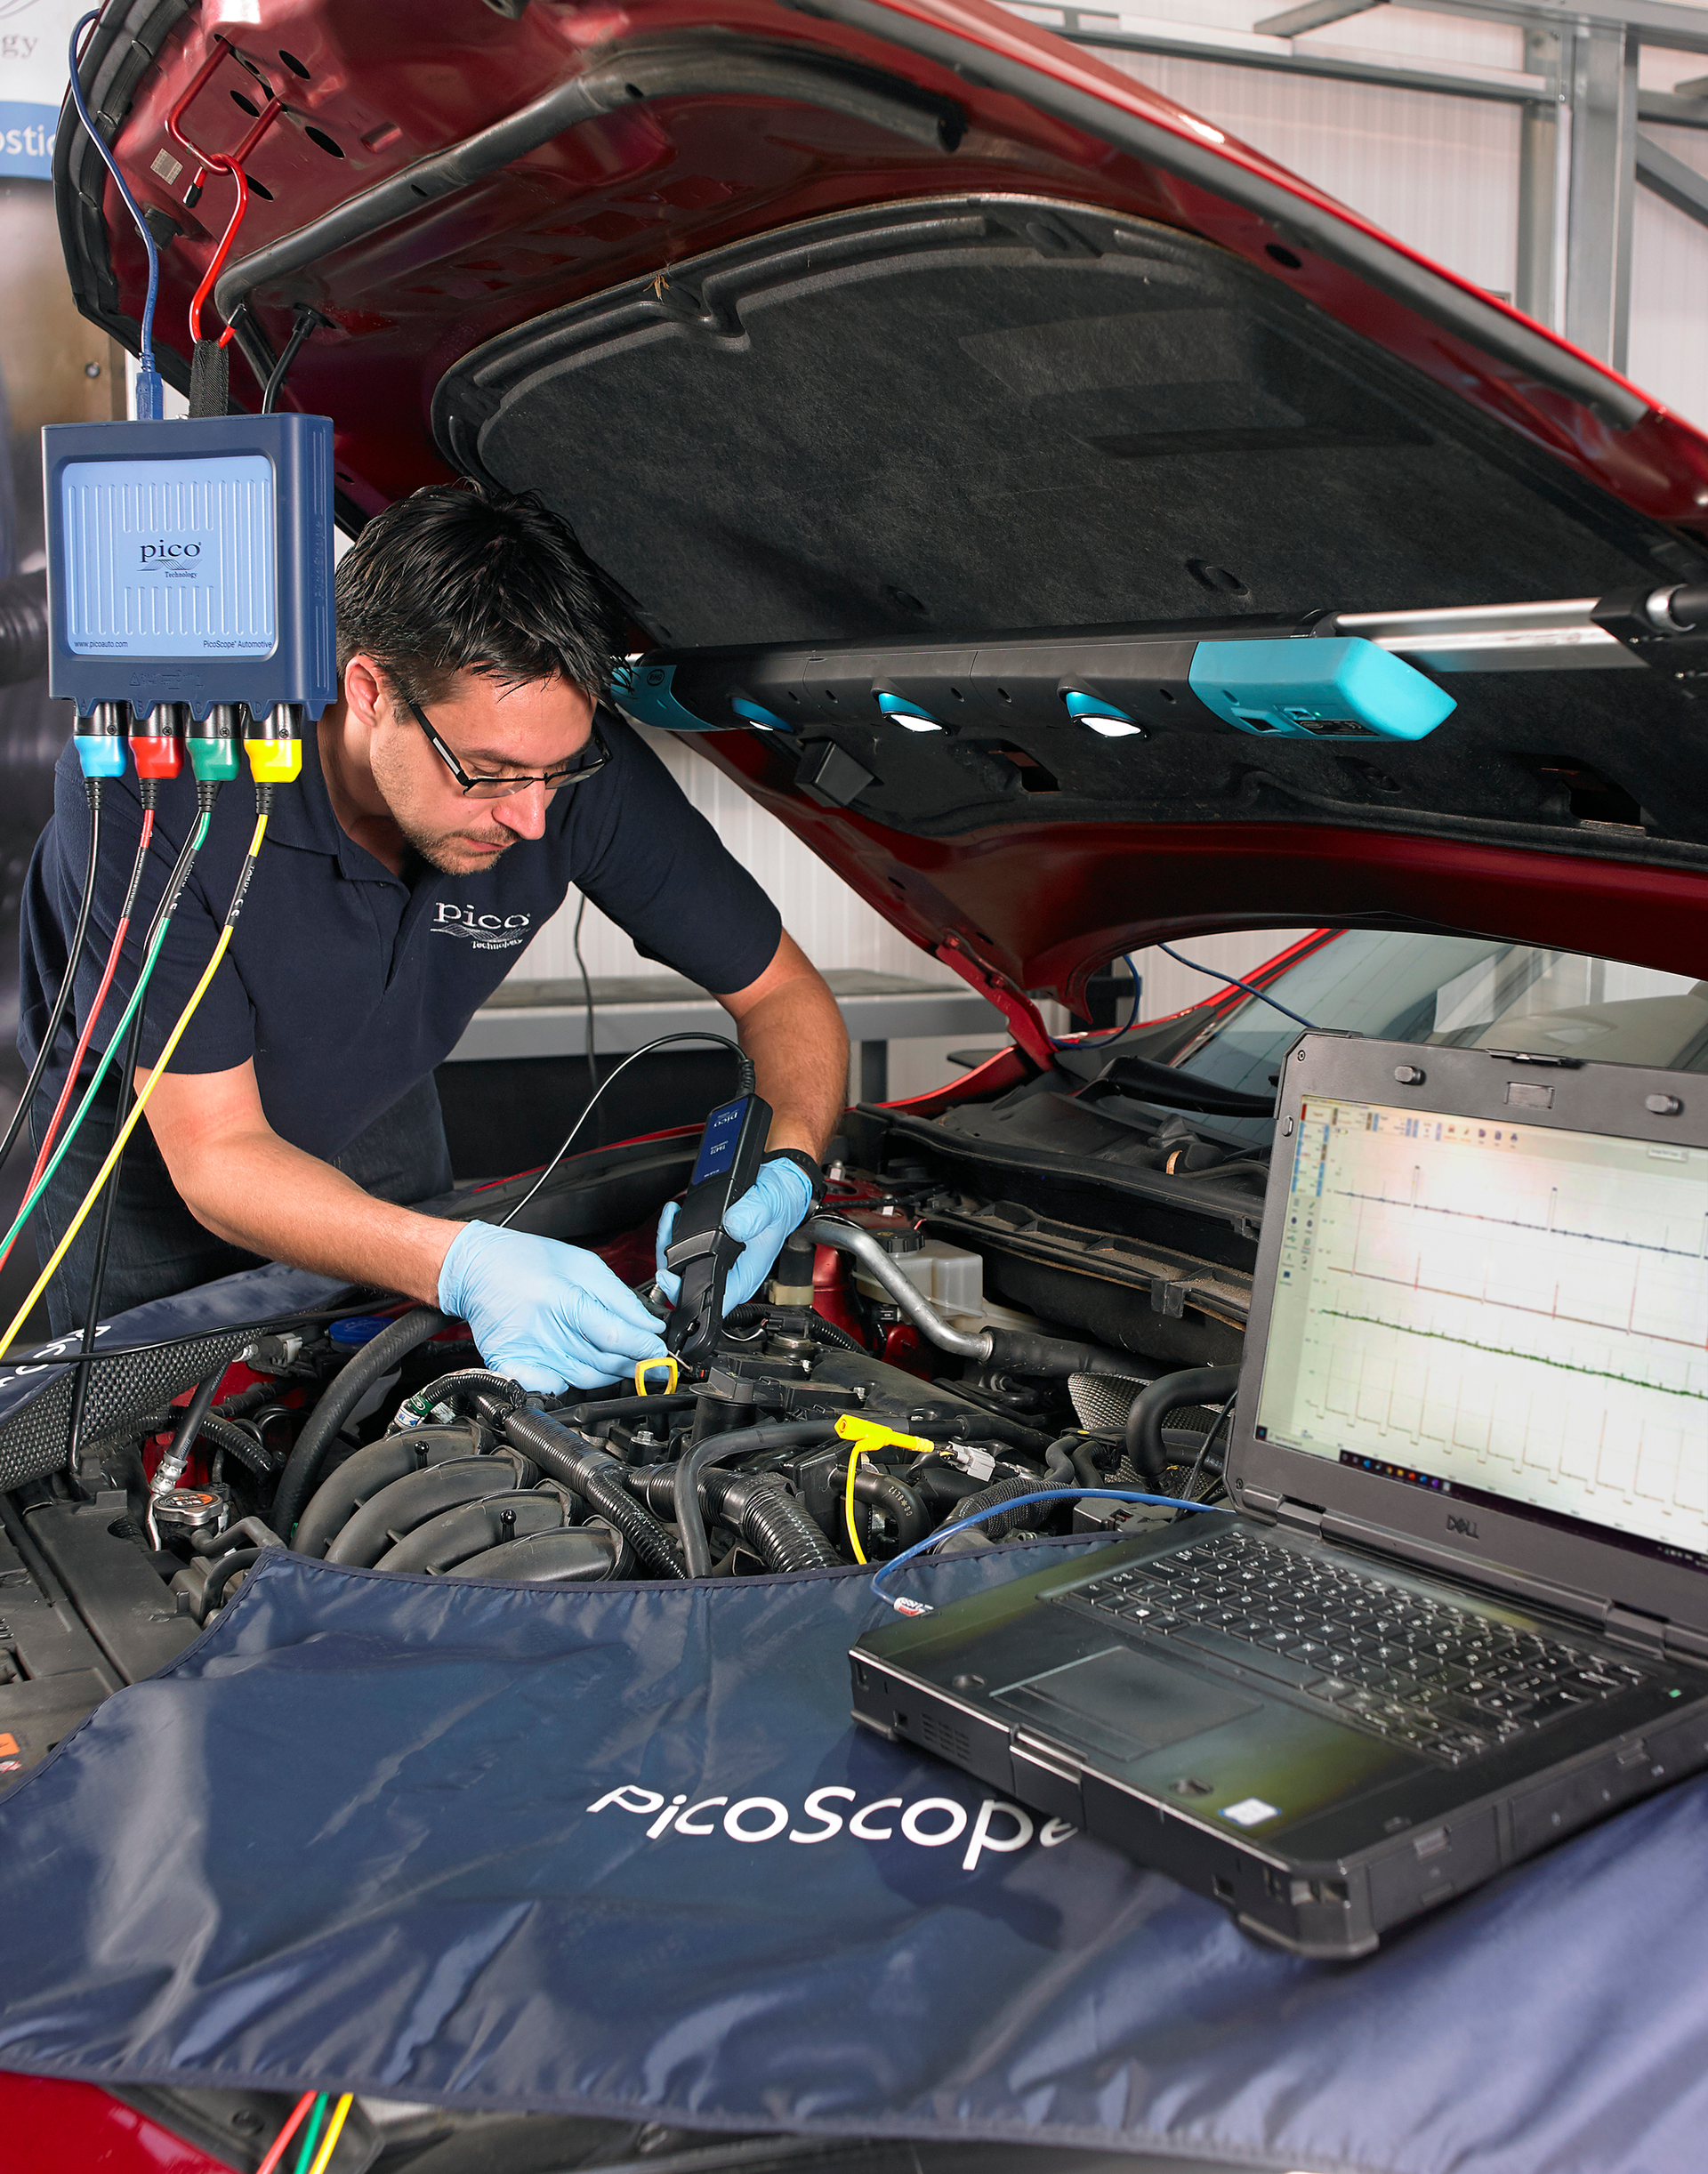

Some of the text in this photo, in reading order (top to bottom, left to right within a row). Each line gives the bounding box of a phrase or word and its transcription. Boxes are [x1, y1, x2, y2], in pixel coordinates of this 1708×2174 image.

[140, 539, 201, 563] pico
[165, 571, 197, 579] Technology
[74, 640, 128, 648] www.picoauto.com
[238, 640, 272, 648] Automotive
[433, 902, 530, 930] pico
[1446, 1514, 1479, 1540] DELL
